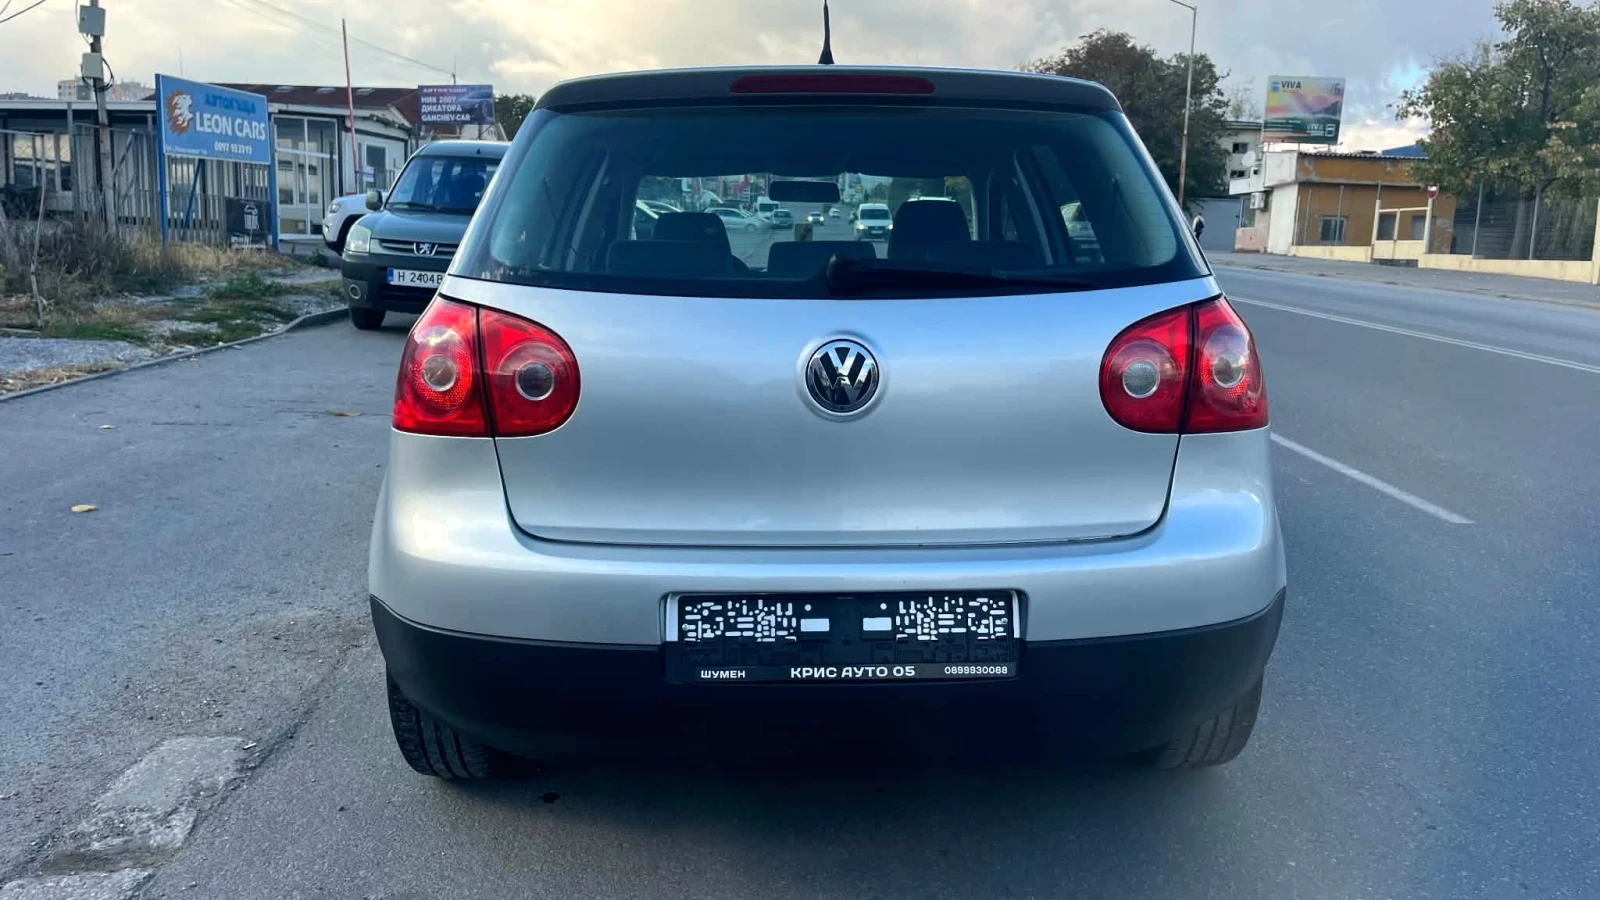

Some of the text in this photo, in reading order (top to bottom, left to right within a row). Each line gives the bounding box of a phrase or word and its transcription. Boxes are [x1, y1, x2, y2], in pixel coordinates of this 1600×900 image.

[1281, 80, 1302, 89] VIVA
[421, 96, 437, 104] НИК
[421, 104, 462, 113] ДИКАТОРА
[421, 113, 471, 122] GANCHEV-CAR
[195, 112, 266, 140] LEON CARS
[398, 271, 405, 282] H
[410, 272, 434, 284] 2404
[700, 669, 746, 679] ШУМЕН
[790, 665, 916, 679] КРИС АУТО 05
[944, 666, 1008, 675] 0899930088
